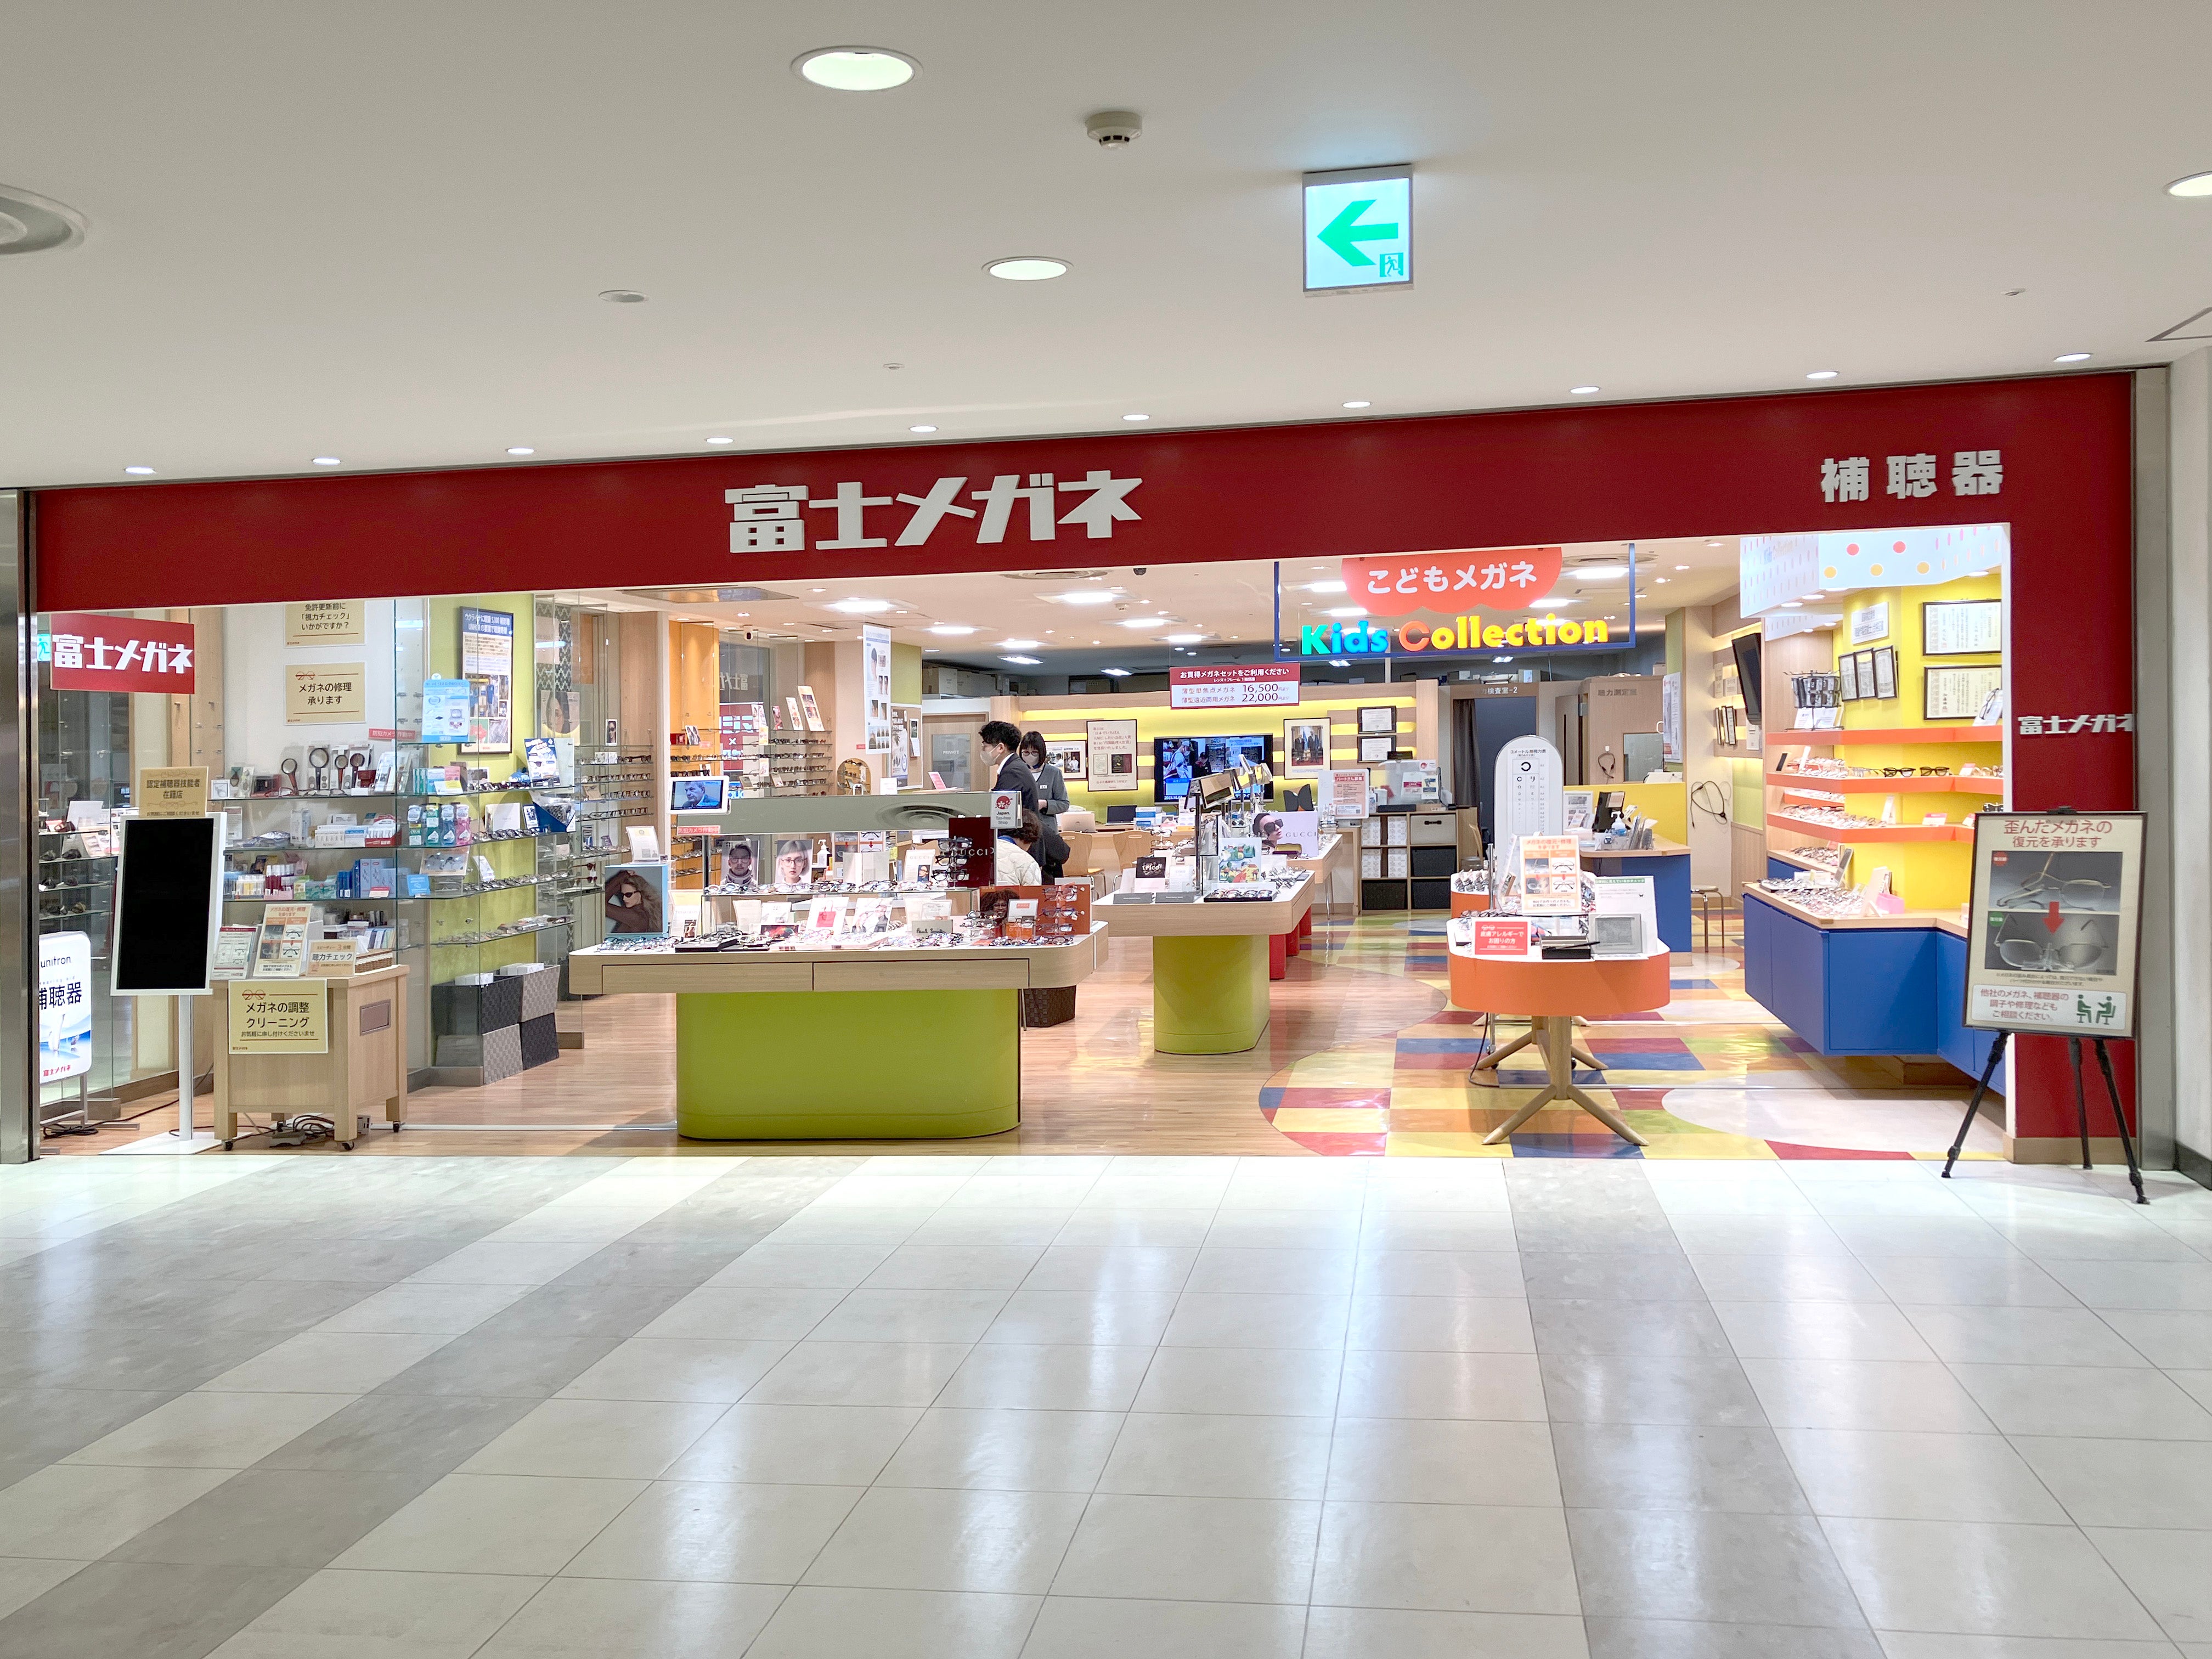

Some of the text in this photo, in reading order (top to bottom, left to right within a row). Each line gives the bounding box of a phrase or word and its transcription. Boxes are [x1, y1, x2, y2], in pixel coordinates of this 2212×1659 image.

[1821, 450, 2004, 503] 補聴器
[725, 470, 1143, 554] 富士メガネ
[1367, 561, 1537, 594] こどもメガネ
[301, 612, 349, 621] 「視力チェック」
[1302, 613, 1609, 655] Kids Collection
[52, 634, 193, 674] 富士メガネ
[298, 682, 352, 693] メガネの修理
[307, 695, 343, 706] 承ります
[2004, 820, 2112, 836] 歪んだメガネの
[2012, 836, 2102, 848] 復元を承ります
[41, 956, 71, 968] unitron
[312, 953, 352, 961] 聴力チェック
[246, 1002, 309, 1013] メガネの調整
[246, 1017, 310, 1028] クリーニング
